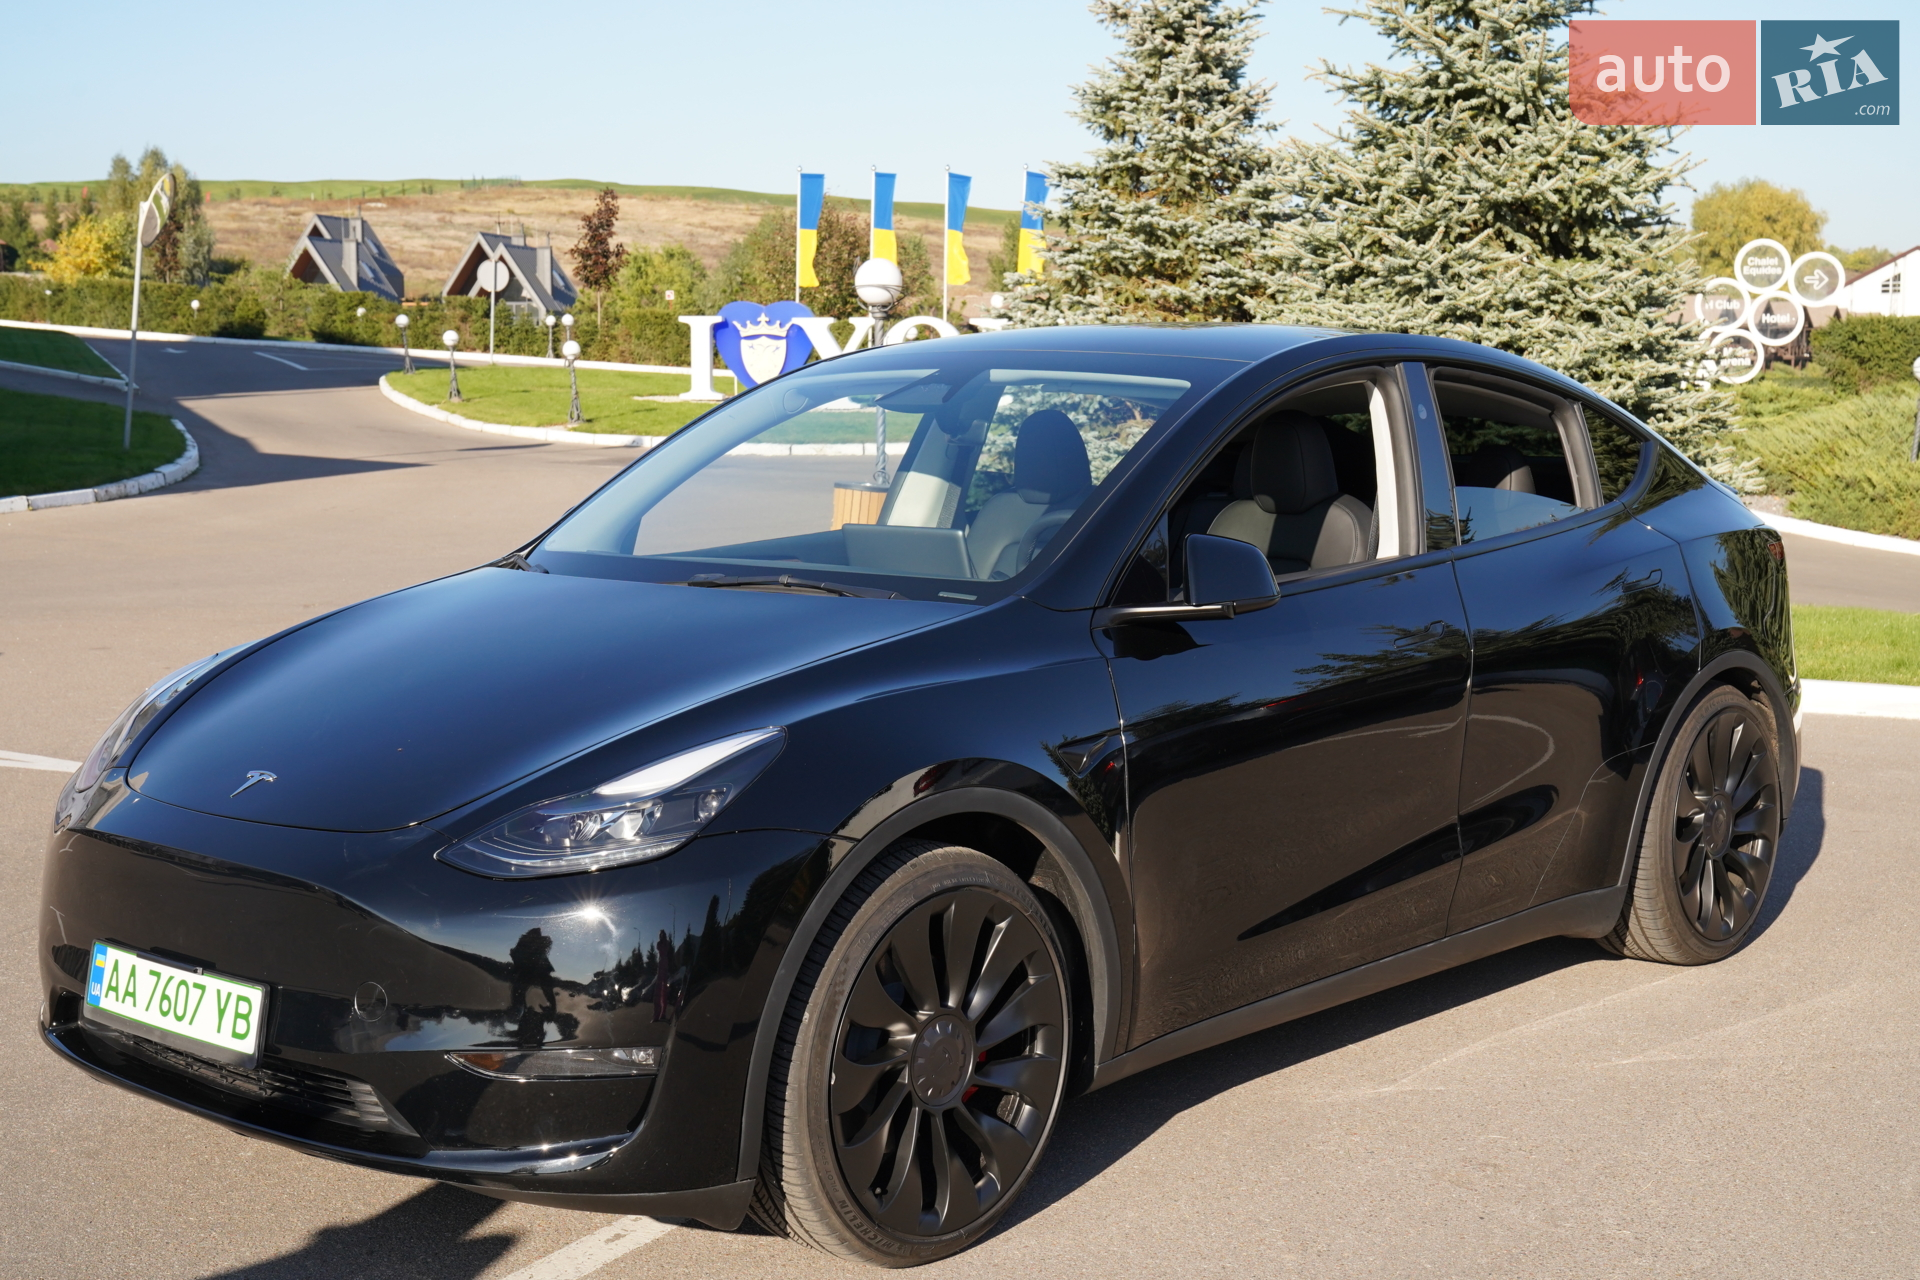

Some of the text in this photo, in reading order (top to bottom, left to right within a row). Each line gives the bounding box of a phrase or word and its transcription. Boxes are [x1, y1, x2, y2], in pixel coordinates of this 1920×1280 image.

[1747, 256, 1778, 266] Chalet
[1743, 266, 1782, 276] Equides
[1715, 300, 1740, 310] Club
[1762, 313, 1790, 323] Hotel
[91, 981, 101, 997] UA
[104, 958, 253, 1041] AA 7607 YB
[817, 1134, 829, 1166] SPORT
[825, 1169, 840, 1193] PILOT
[838, 1199, 900, 1250] MICHELIN
